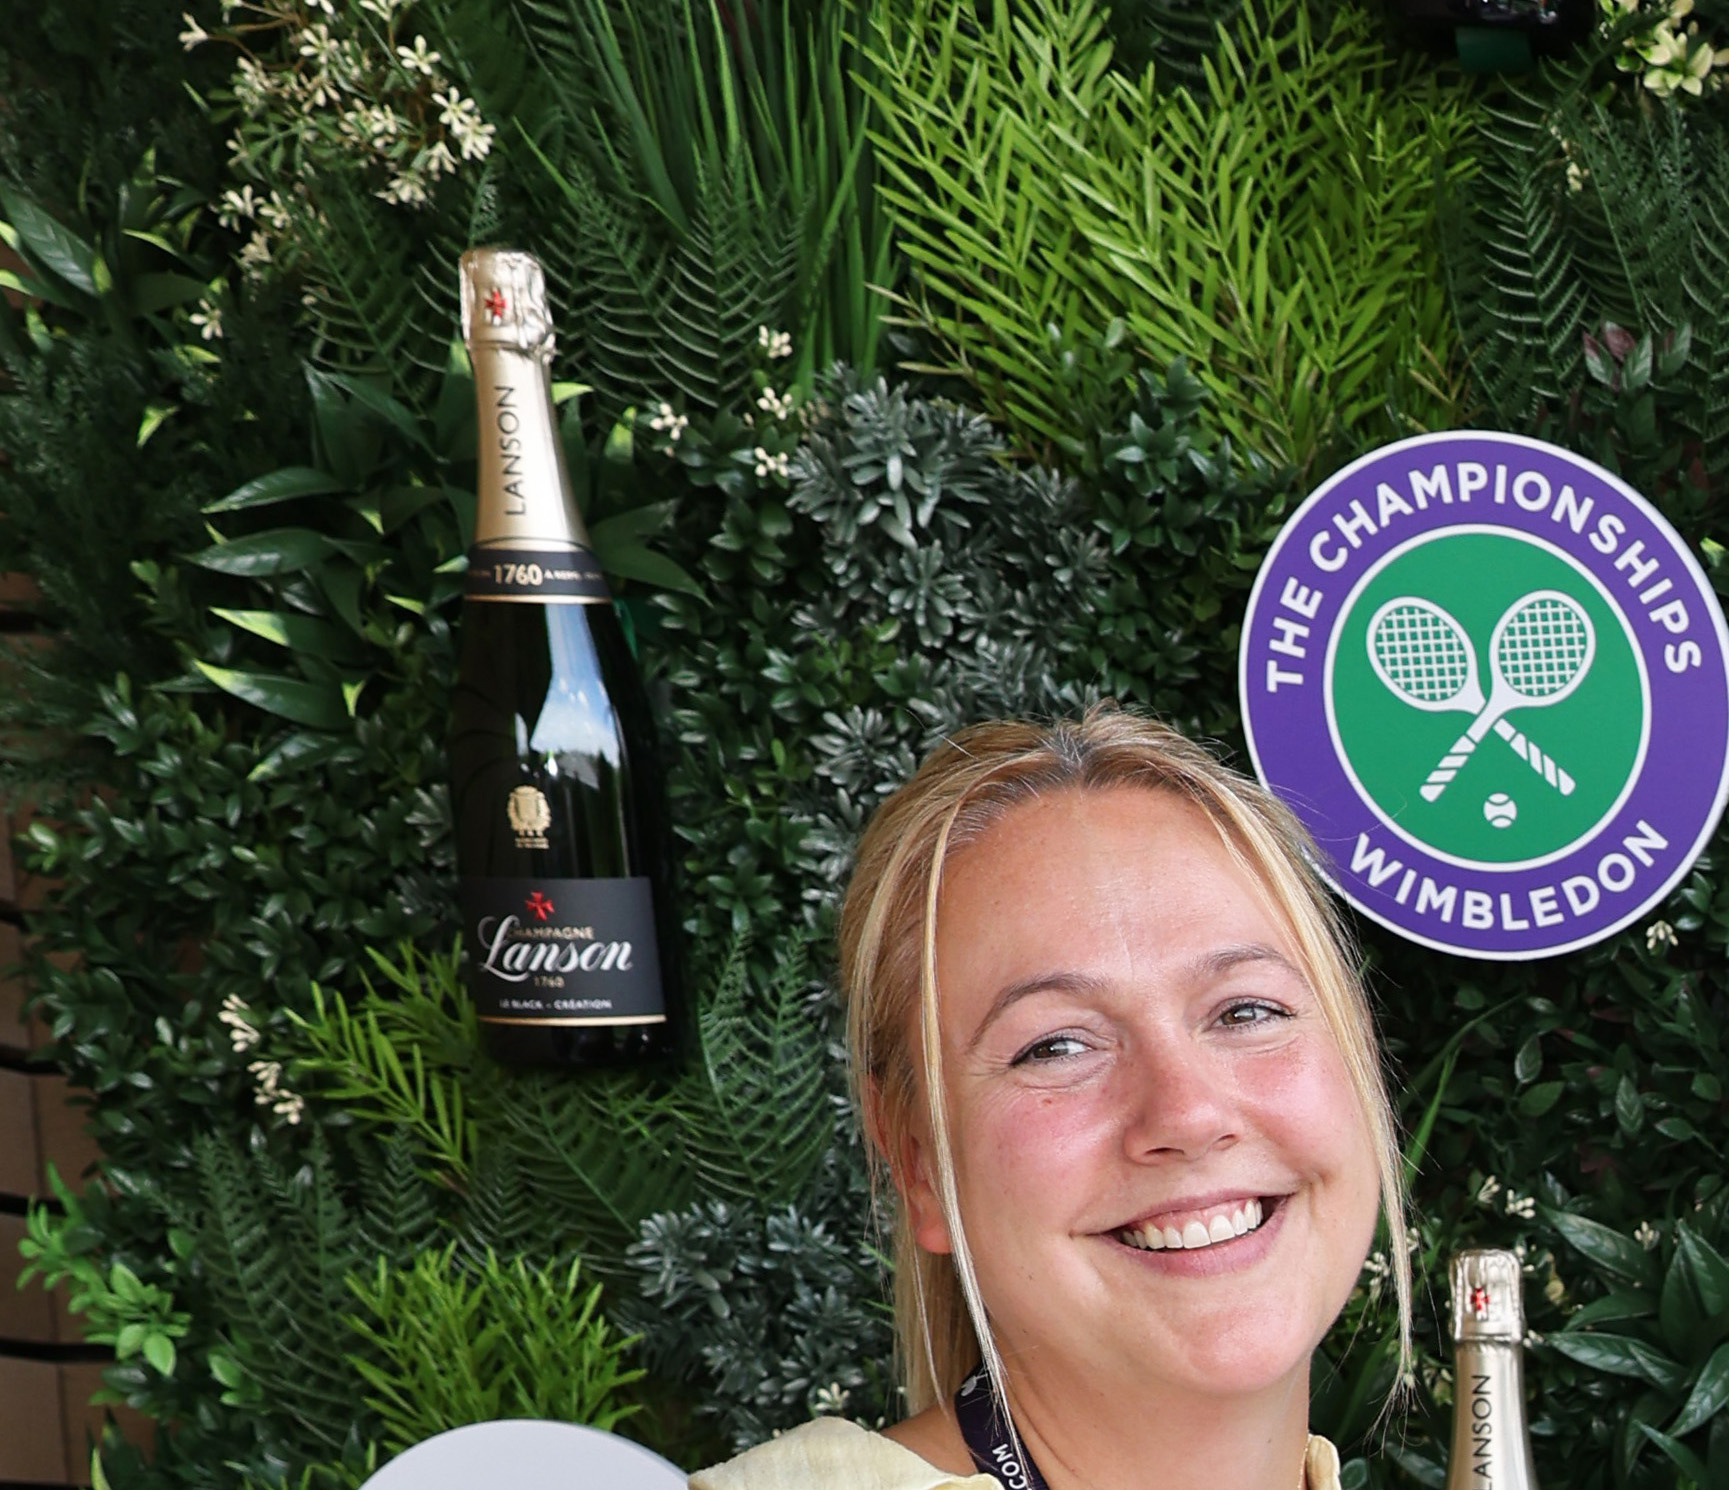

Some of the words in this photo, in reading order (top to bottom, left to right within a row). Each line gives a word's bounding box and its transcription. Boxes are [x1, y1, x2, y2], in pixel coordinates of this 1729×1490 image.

[494, 385, 526, 516] LANSON
[494, 563, 543, 586] 1760
[1266, 577, 1323, 692] THE
[1309, 462, 1702, 674] CHAMPIONSHIPS
[1349, 820, 1670, 931] WIMBLEDON
[478, 914, 633, 982] Lanson
[508, 926, 594, 940] CHAMPAGNE
